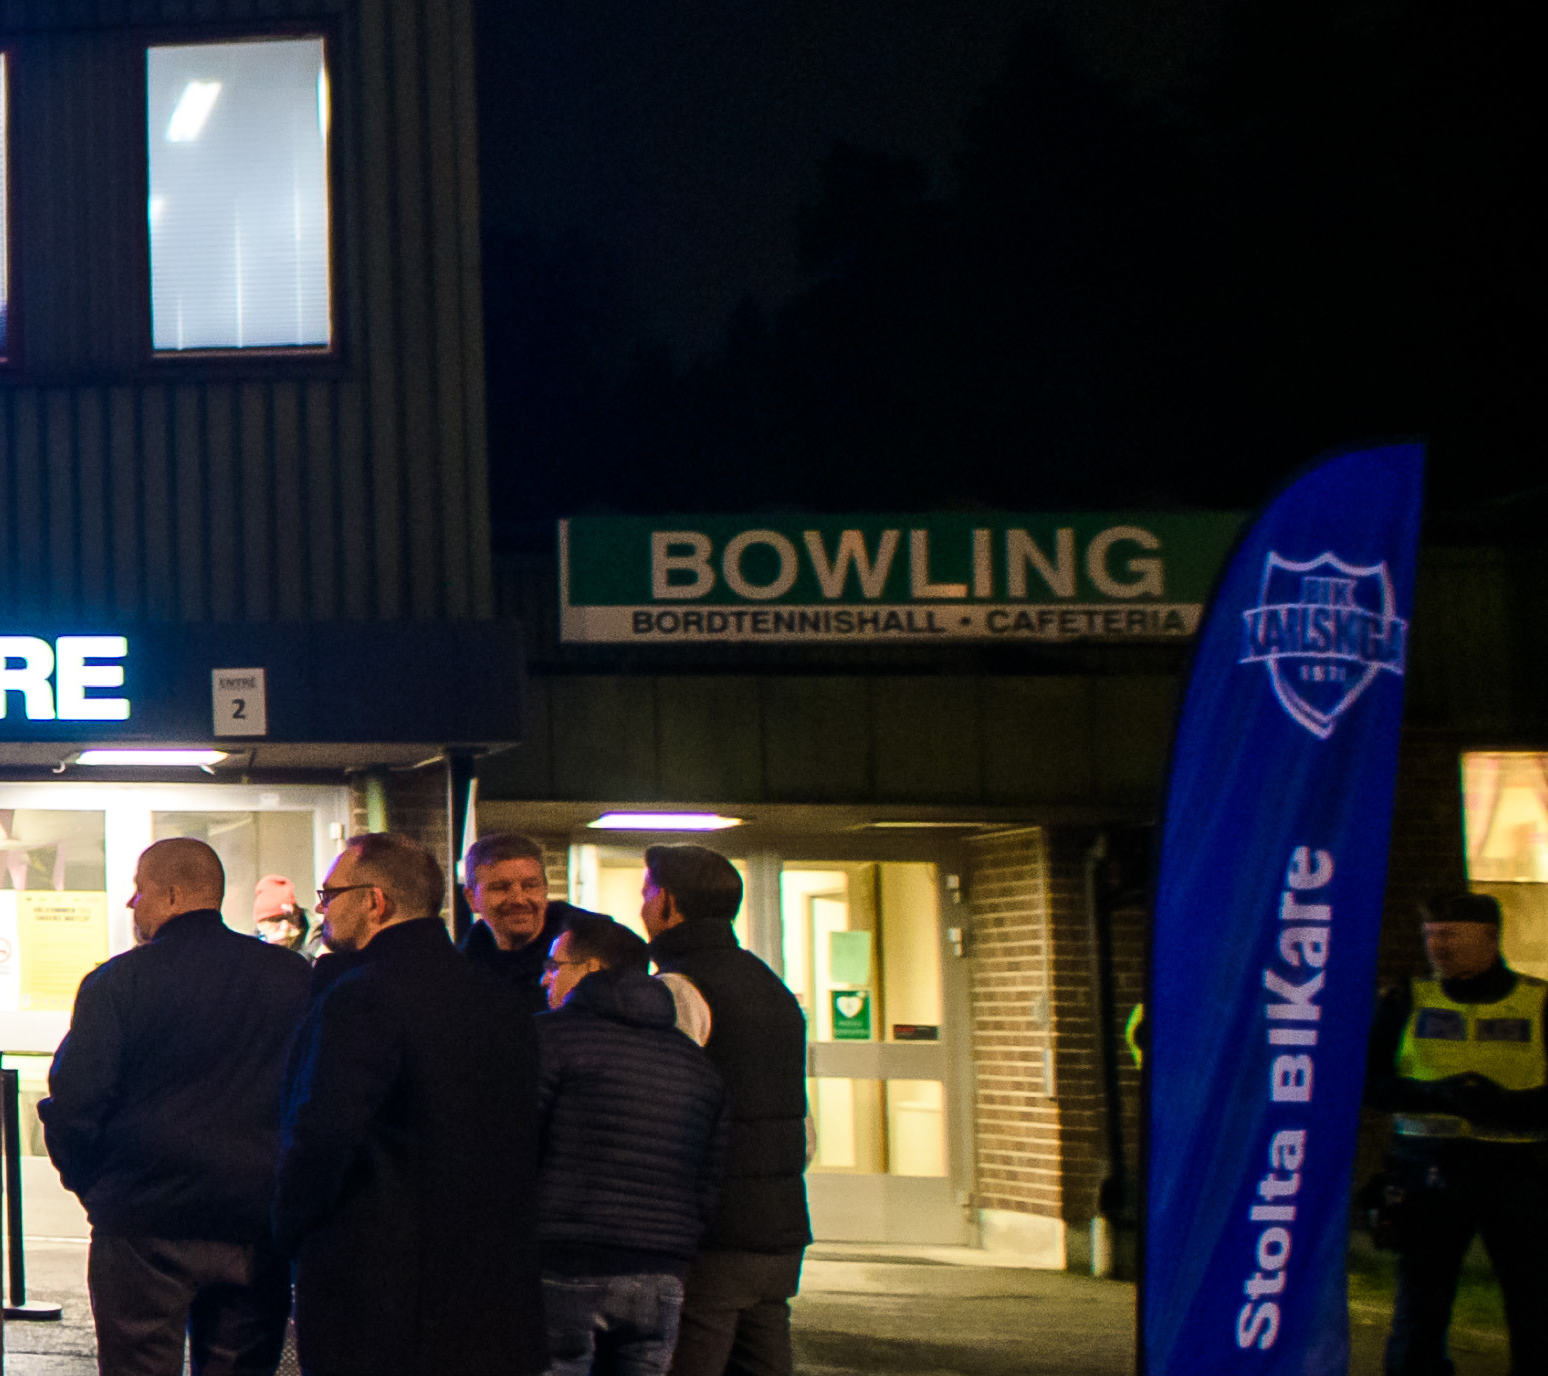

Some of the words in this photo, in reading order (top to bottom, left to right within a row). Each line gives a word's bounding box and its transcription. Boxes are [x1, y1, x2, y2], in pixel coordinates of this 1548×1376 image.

[650, 526, 1165, 600] BOWLING
[631, 610, 947, 636] BORDTENNISHALL
[985, 607, 1186, 636] CAFETERIA
[232, 699, 246, 719] 2
[1262, 845, 1335, 1103] BIKare
[1235, 1129, 1307, 1350] Stolta
